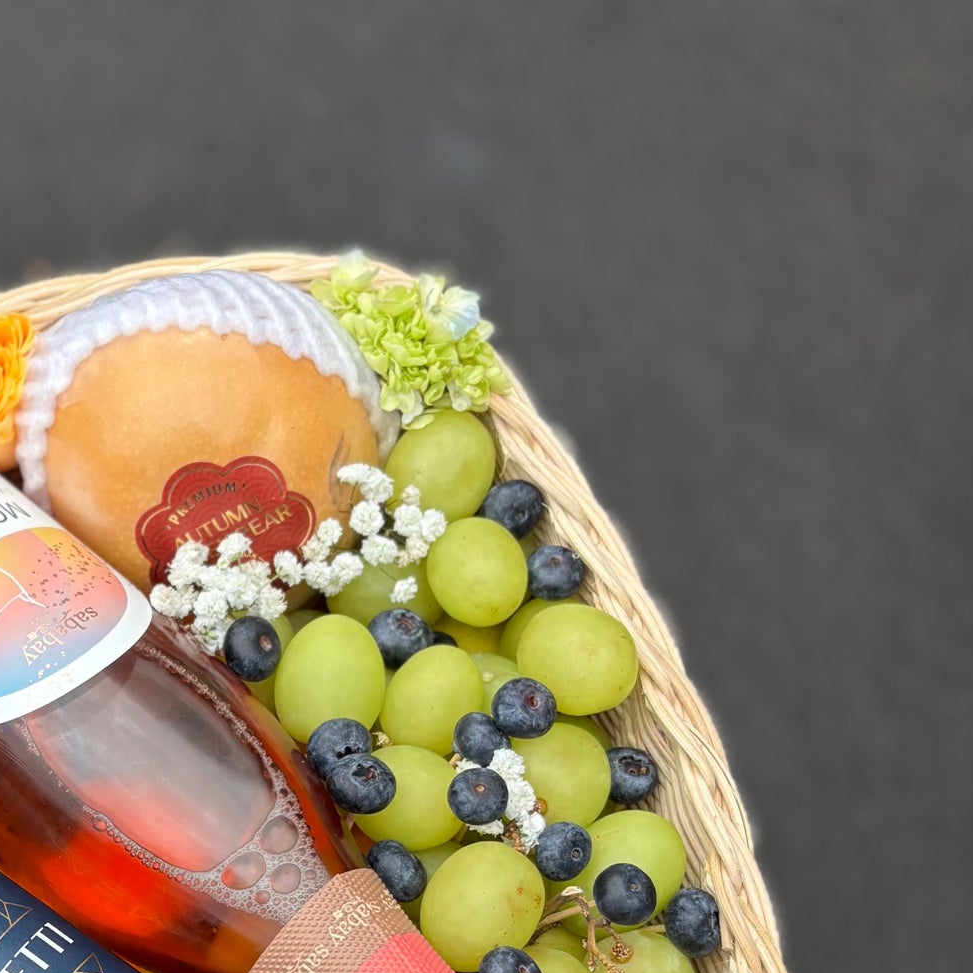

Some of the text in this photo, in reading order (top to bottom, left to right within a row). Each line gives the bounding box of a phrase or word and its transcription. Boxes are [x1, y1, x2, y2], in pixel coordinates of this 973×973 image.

[168, 482, 237, 526] PREMIUM
[175, 495, 262, 549] AUTUMN
[23, 606, 98, 667] sababay
